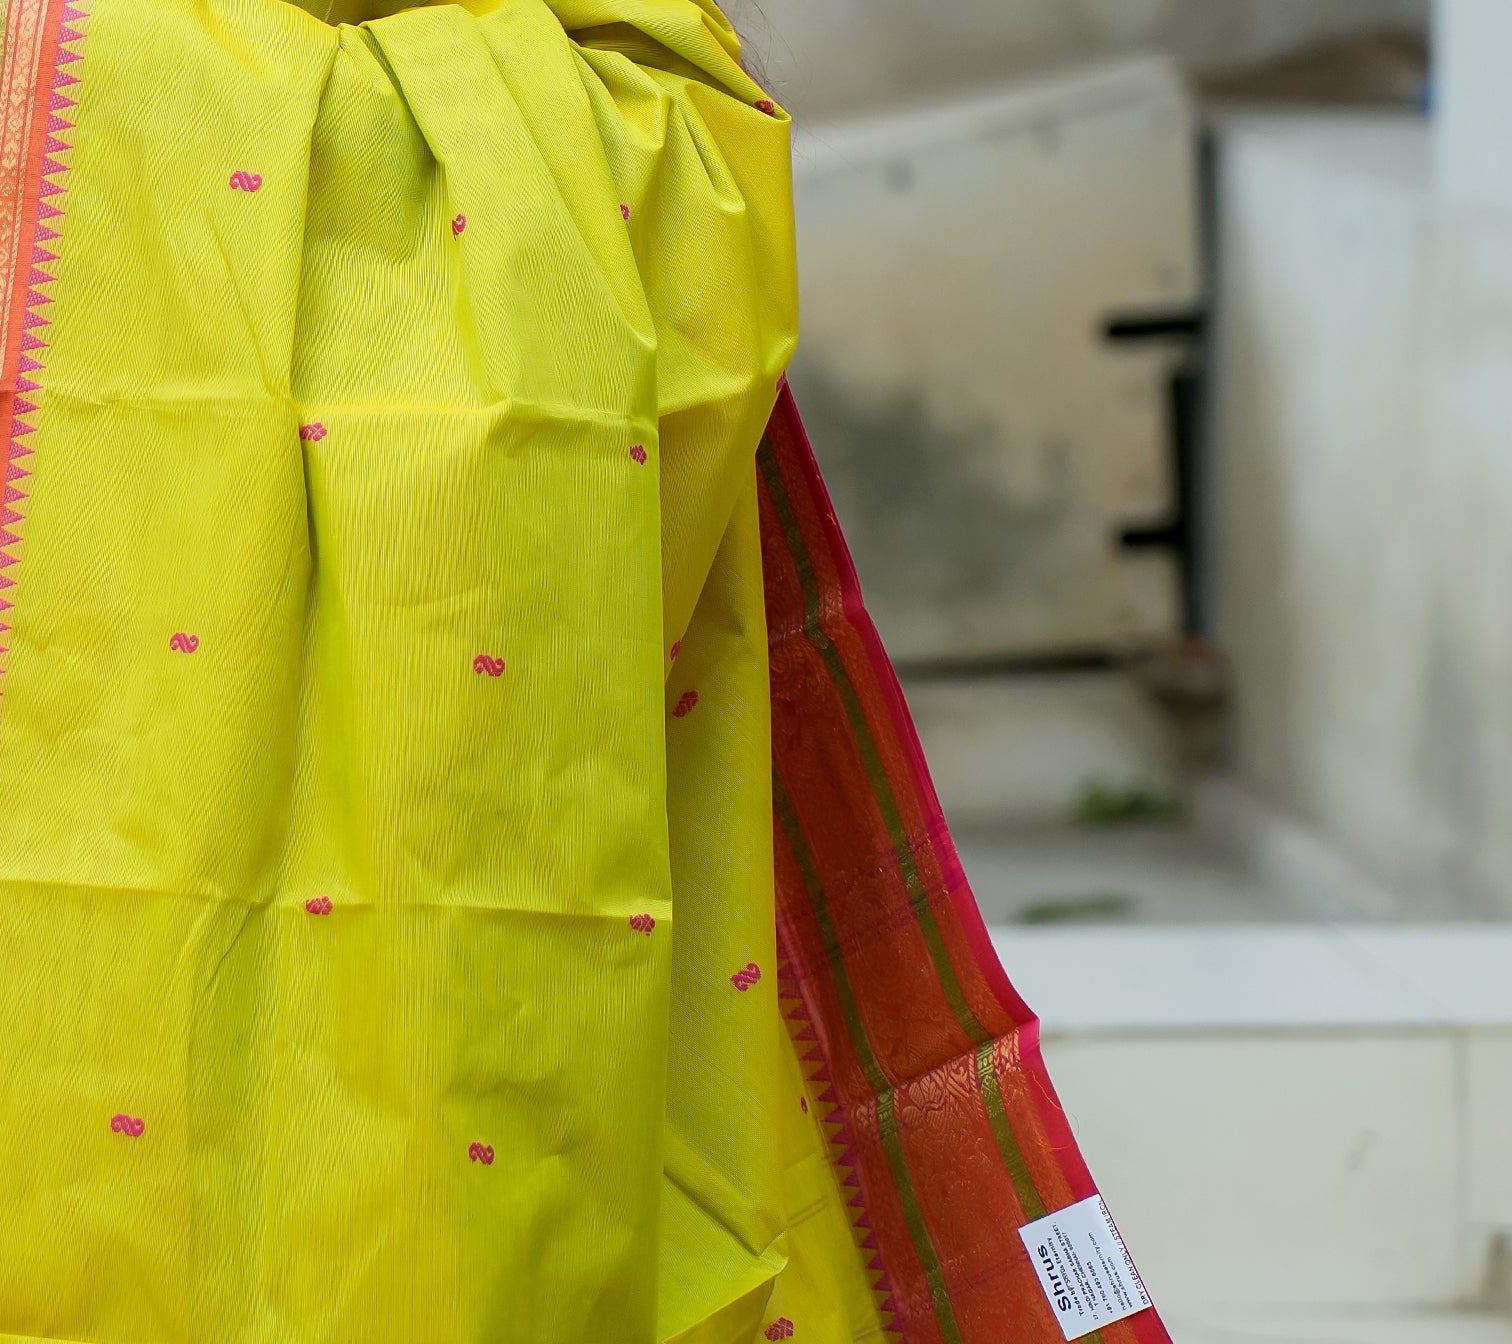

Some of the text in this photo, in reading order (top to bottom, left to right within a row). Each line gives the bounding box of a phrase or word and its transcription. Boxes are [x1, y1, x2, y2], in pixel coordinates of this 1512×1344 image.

[1105, 1217, 1119, 1241] STEAM
[1046, 1237, 1062, 1265] Eternity
[1062, 1247, 1075, 1267] SABHA
[1118, 1247, 1131, 1266] ONLY
[1037, 1244, 1072, 1312] Shrus
[1072, 1267, 1088, 1296] PRACHAR
[1107, 1256, 1133, 1309] www.shrus.com
[1127, 1265, 1142, 1290] CLEAN
[1073, 1296, 1085, 1317] Trade
[1137, 1290, 1150, 1306] DRY
